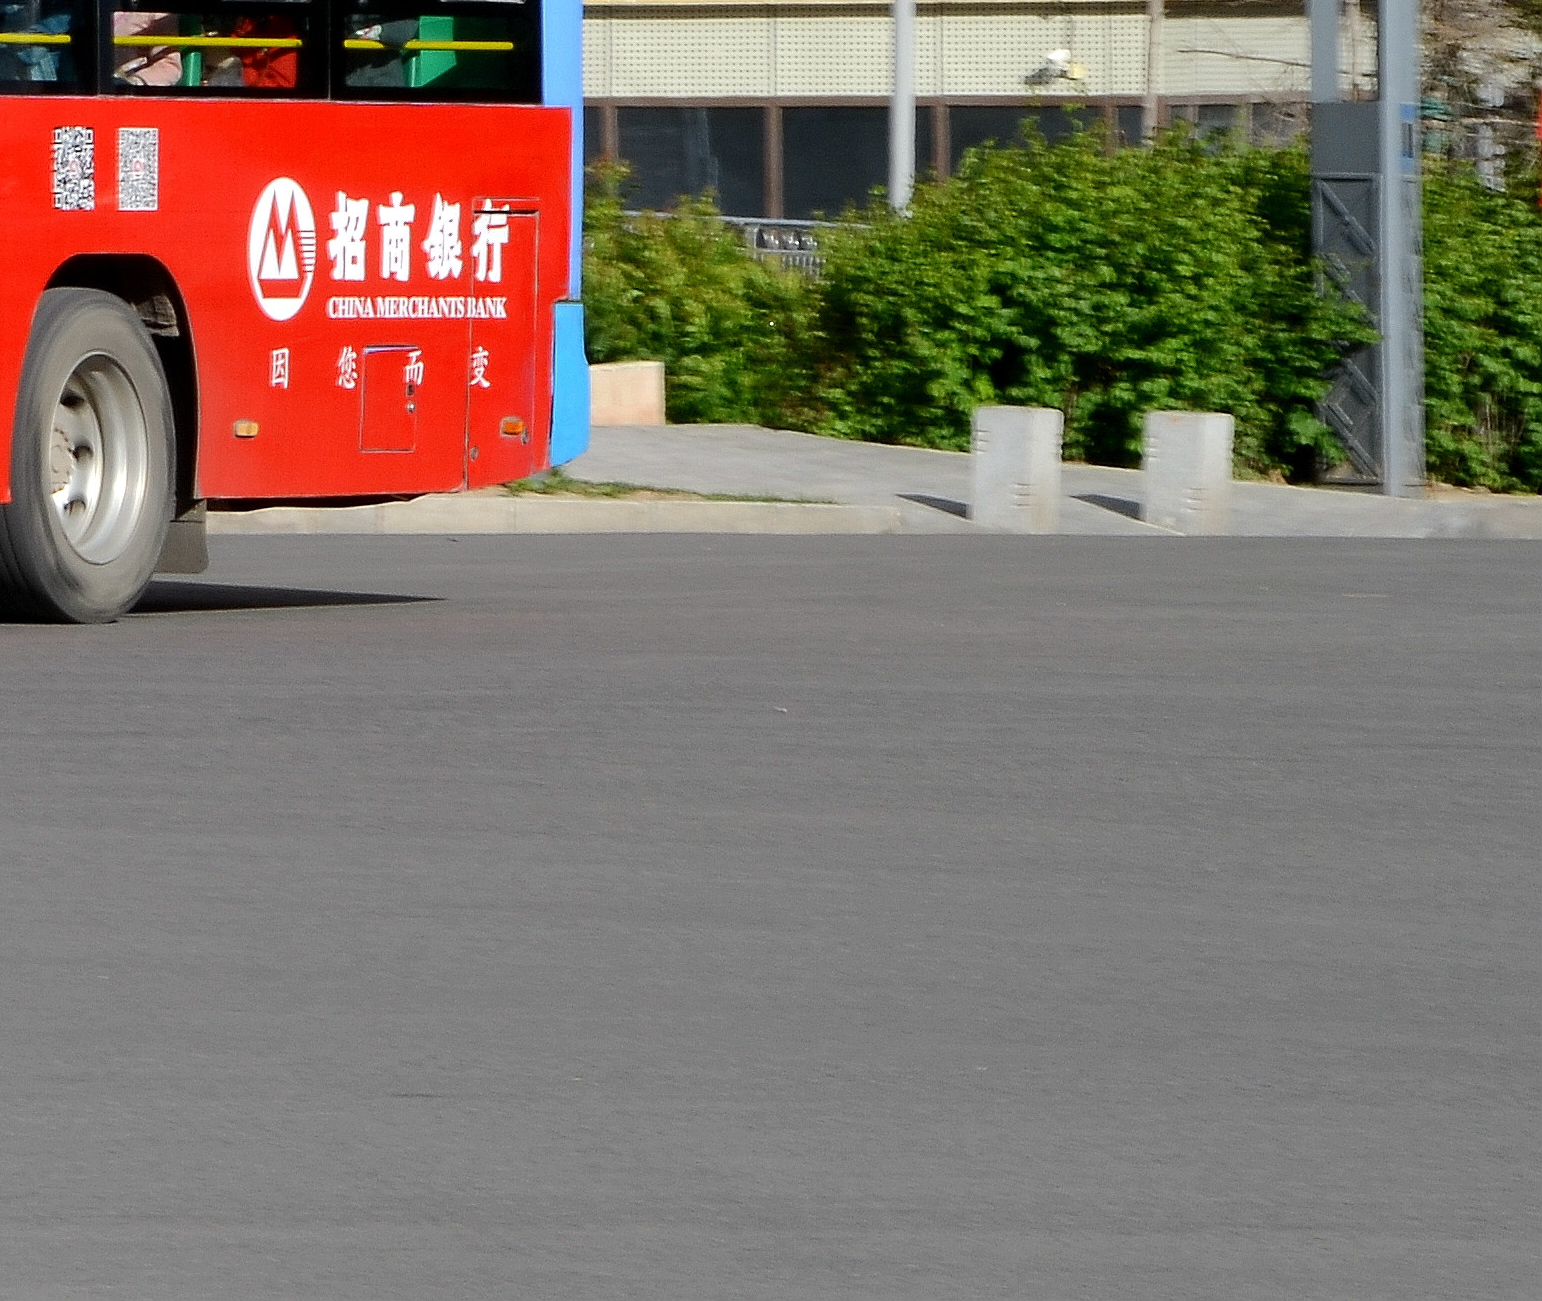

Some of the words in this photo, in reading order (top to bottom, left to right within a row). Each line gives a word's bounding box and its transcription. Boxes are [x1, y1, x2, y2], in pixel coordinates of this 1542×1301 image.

[326, 190, 512, 284] 招商银行
[327, 296, 375, 320] CHINA
[376, 296, 466, 320] MERCHANTS
[467, 295, 508, 320] BANK
[269, 345, 492, 390] 因您而变
